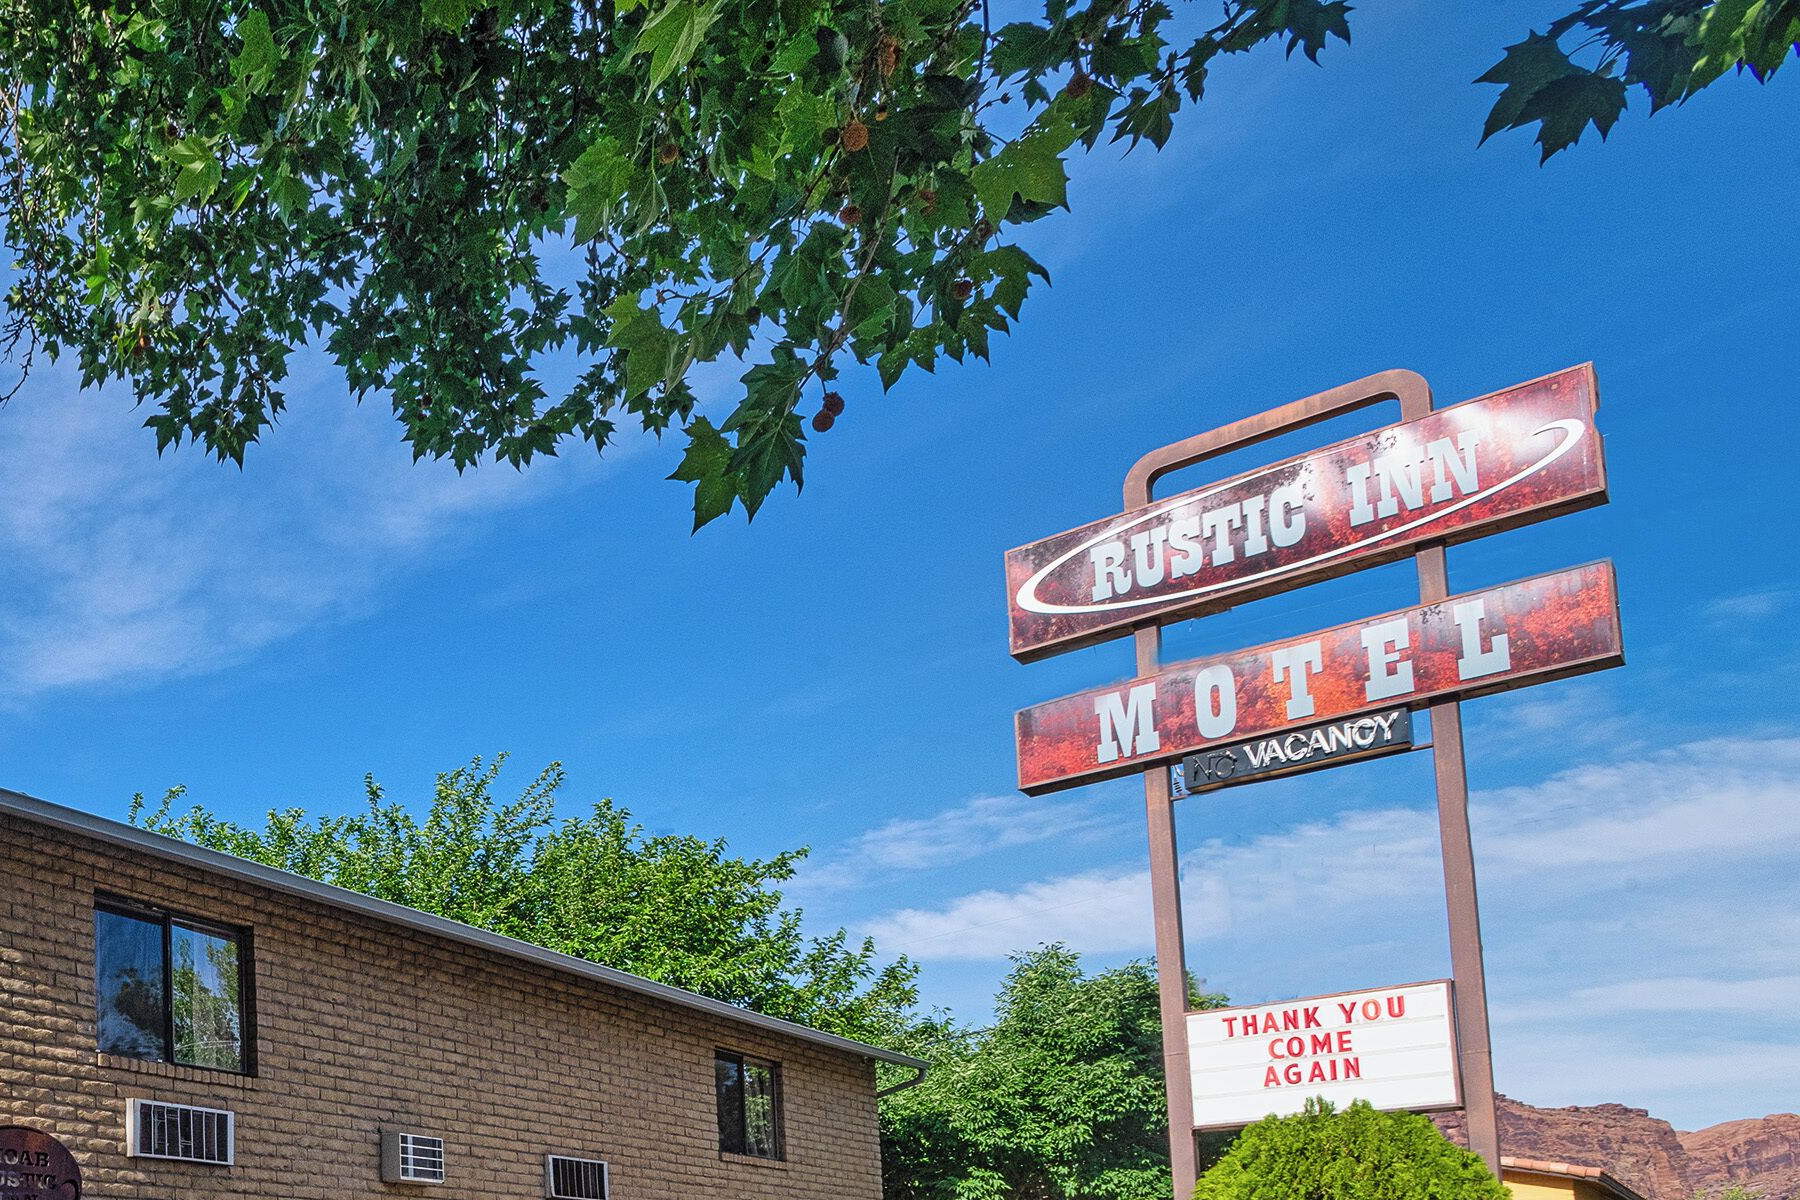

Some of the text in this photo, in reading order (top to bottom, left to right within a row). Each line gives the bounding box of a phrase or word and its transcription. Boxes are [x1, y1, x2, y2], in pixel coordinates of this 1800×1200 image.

[1090, 430, 1482, 602] RUSTIC INN
[1094, 598, 1511, 764] MOTEL
[1193, 711, 1399, 781] NO VACANCY
[1221, 995, 1406, 1038] THANK YOU
[1263, 1057, 1361, 1088] AGAIN
[1268, 1030, 1353, 1060] COME
